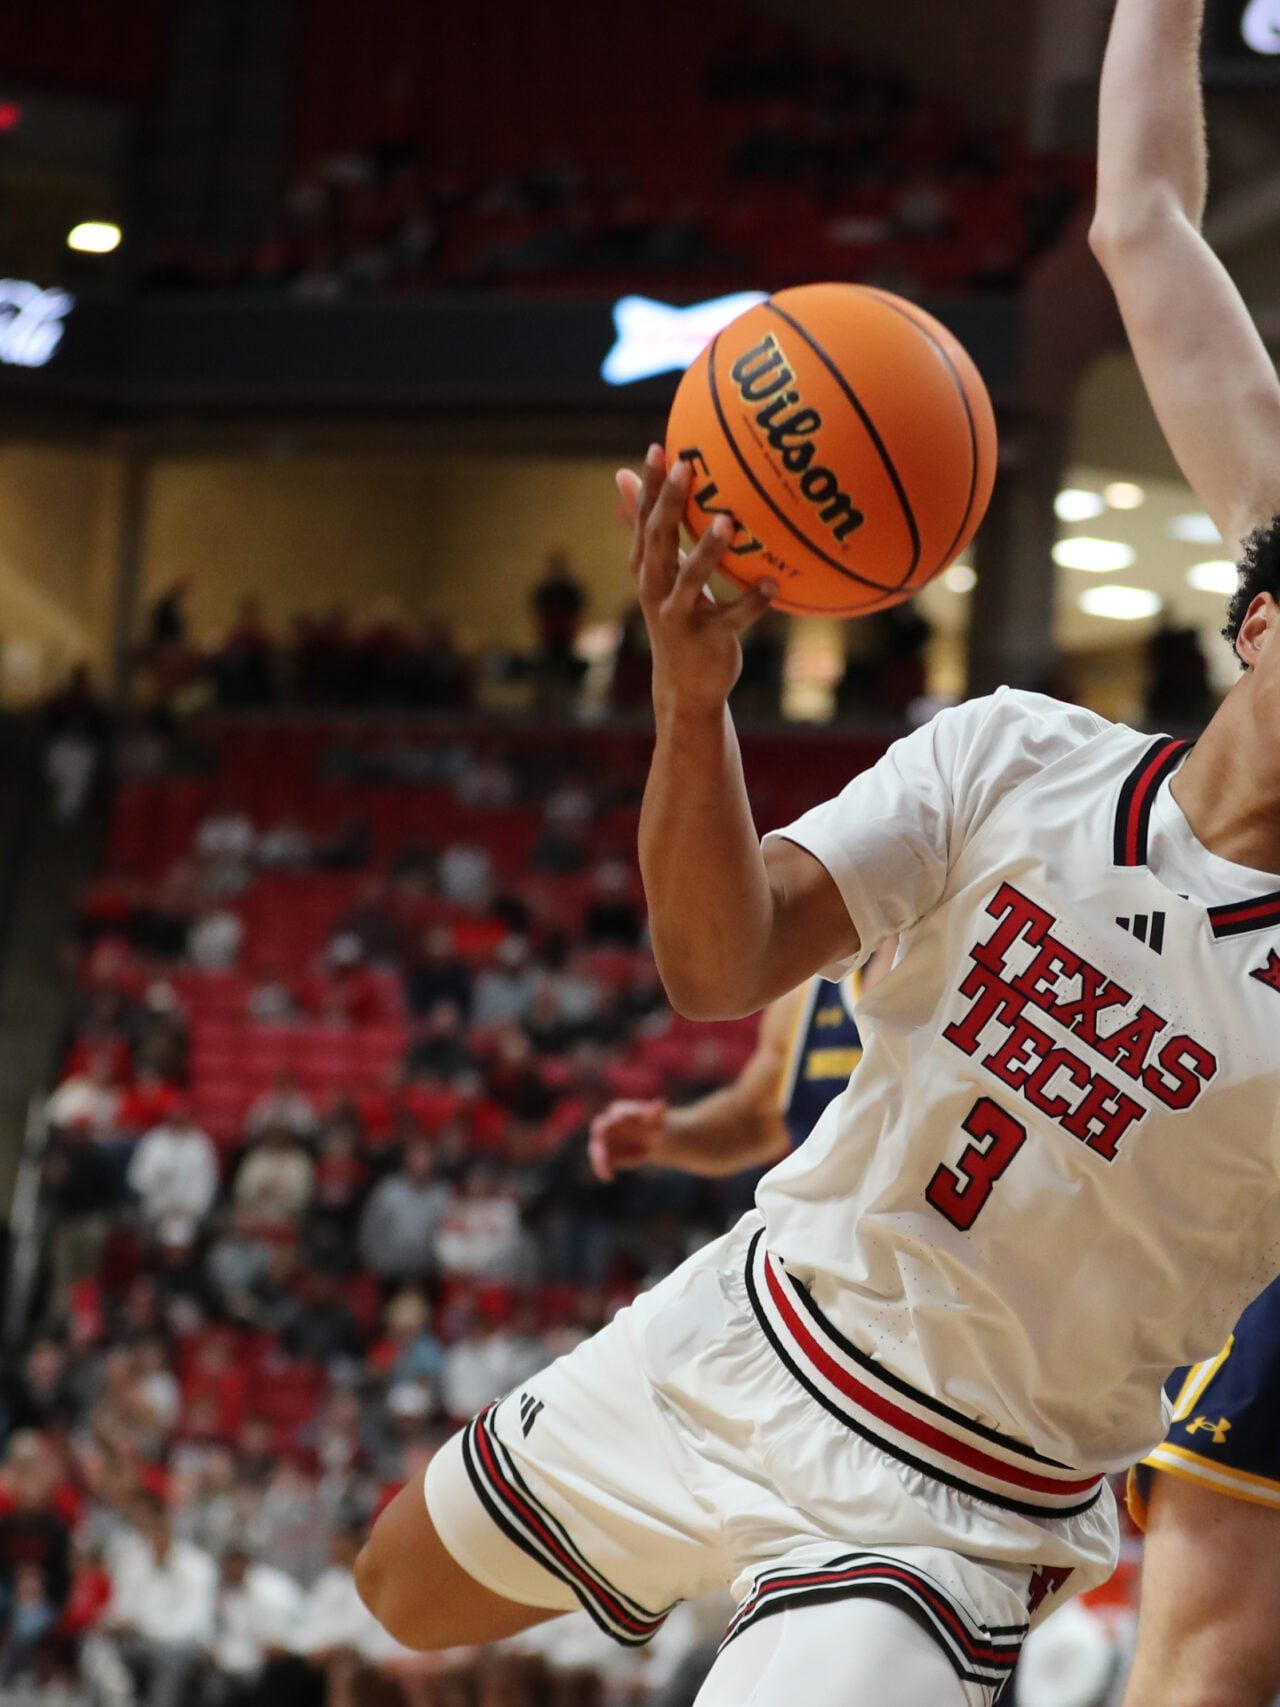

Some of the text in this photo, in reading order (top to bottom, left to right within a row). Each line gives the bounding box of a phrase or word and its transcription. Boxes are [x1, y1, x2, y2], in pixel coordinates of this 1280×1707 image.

[730, 330, 864, 543] Wilson
[941, 961, 1148, 1163] TECH
[969, 881, 1218, 1111] TEXAS
[925, 1096, 1027, 1232] 3
